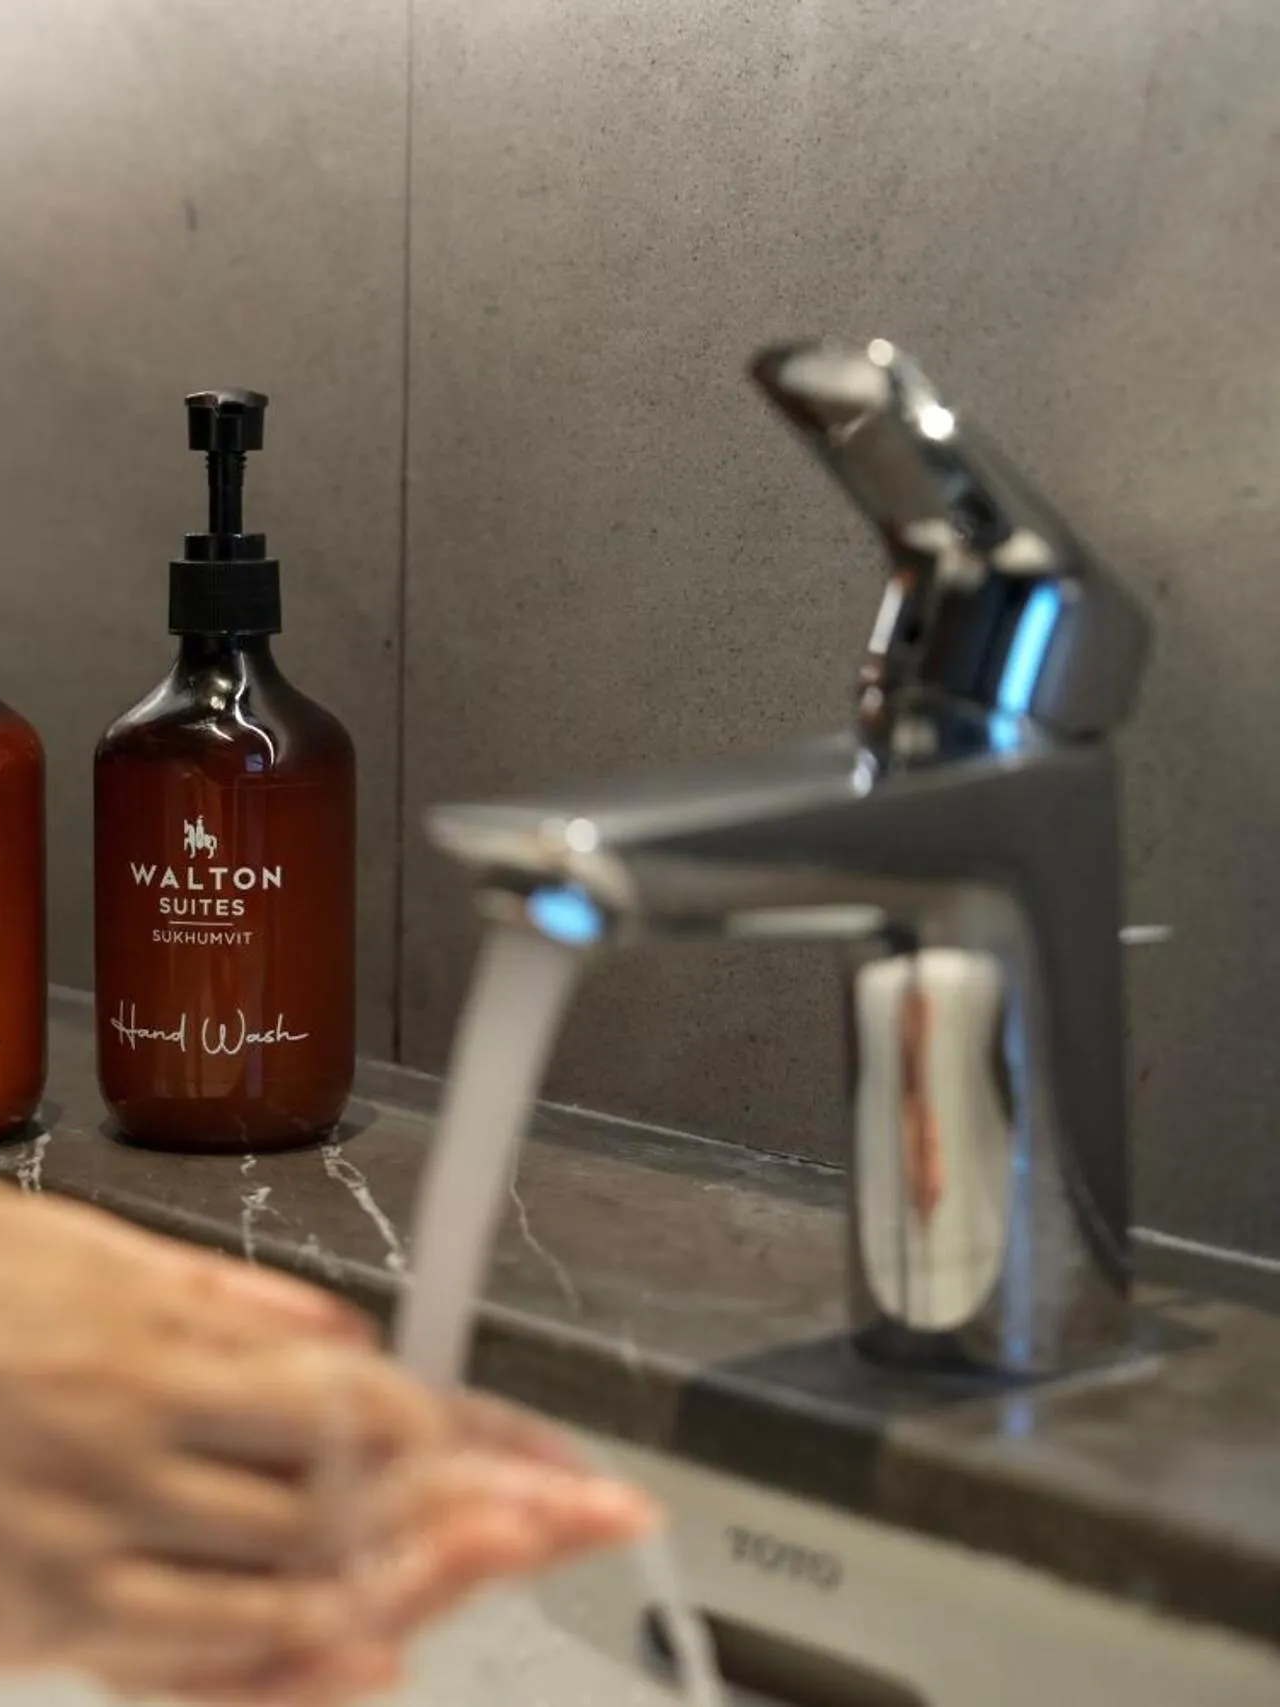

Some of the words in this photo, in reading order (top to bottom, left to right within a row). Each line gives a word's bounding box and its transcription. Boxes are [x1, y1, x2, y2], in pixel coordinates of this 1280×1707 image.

[130, 862, 282, 890] WALTON
[159, 897, 245, 916] SUITES
[152, 929, 253, 945] SUKHUMVIT
[110, 1000, 186, 1052] Hand
[202, 1008, 309, 1054] Wash
